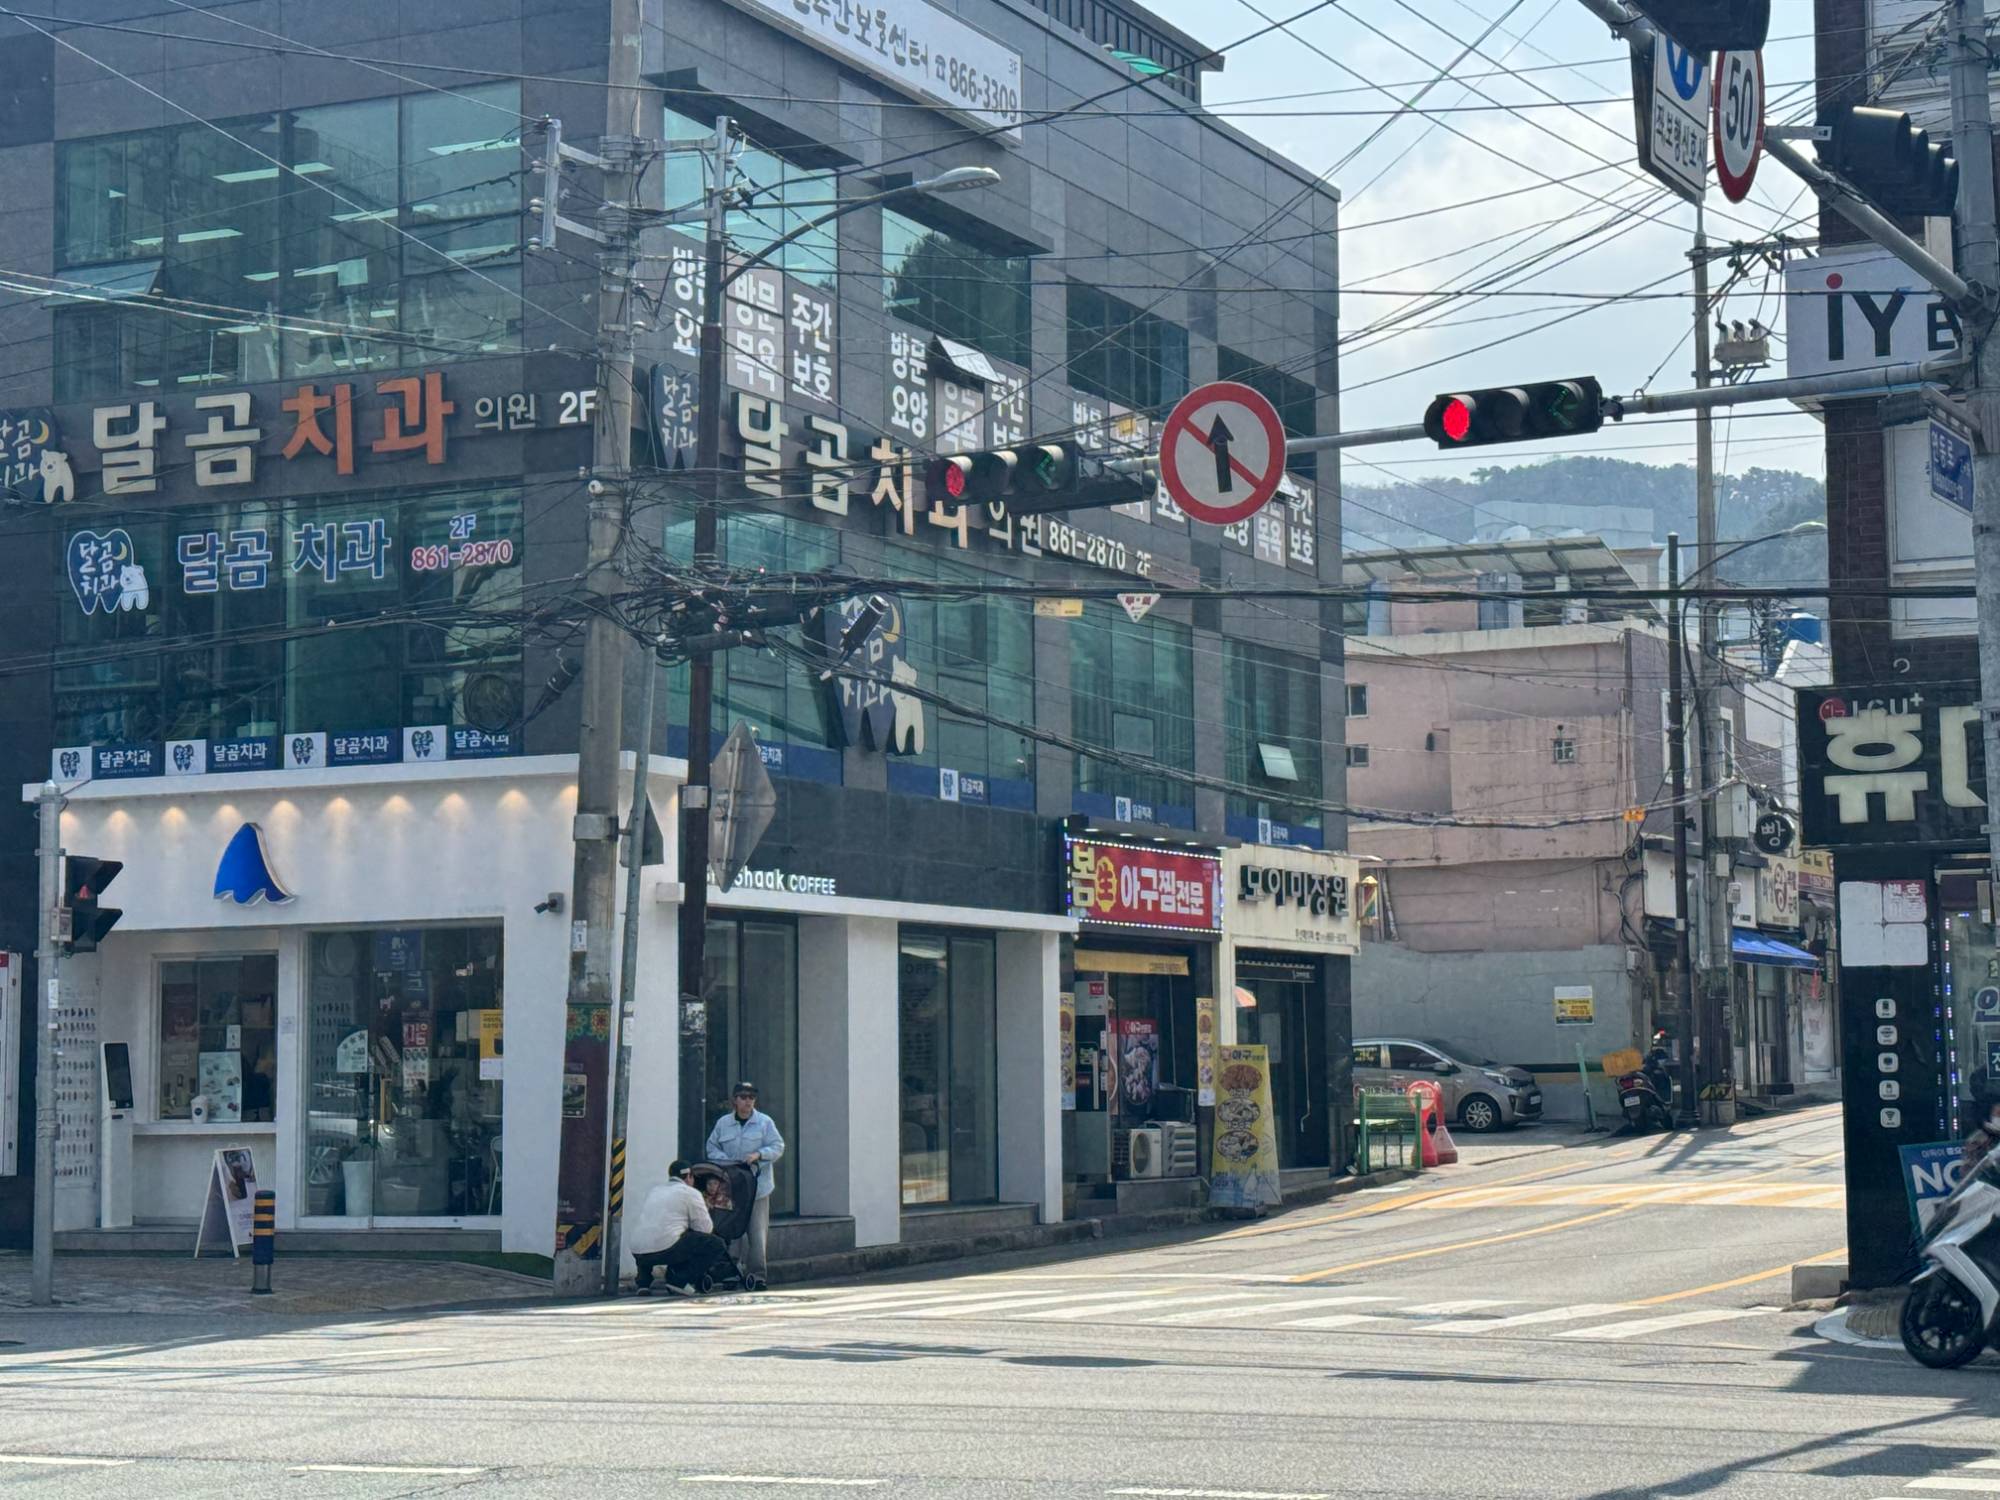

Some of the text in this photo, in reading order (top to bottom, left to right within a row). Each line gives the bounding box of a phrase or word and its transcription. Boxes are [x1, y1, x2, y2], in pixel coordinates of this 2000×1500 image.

[949, 57, 1017, 123] 866-3309
[1725, 56, 1754, 150] 50
[792, 294, 832, 352] 주간
[735, 331, 778, 392] 목욕
[792, 350, 832, 401] 보호
[891, 332, 927, 387] 방문
[662, 375, 692, 424] 달곰
[891, 385, 928, 438] 요양
[92, 371, 597, 494] 달곰치과 의원 2F
[661, 419, 698, 449] 치과
[449, 513, 477, 539] 2F
[1257, 517, 1282, 562] 목욕
[1290, 526, 1314, 566] 보호
[79, 540, 114, 574] 달곰
[411, 539, 513, 571] 861-2870
[1049, 520, 1126, 571] 861-2870
[1136, 550, 1152, 578] 2F
[80, 573, 120, 596] 치과
[99, 750, 151, 769] 달곰치과
[213, 742, 268, 762] 달곰치과
[333, 735, 389, 755] 달곰치과
[789, 873, 837, 895] COFFEE
